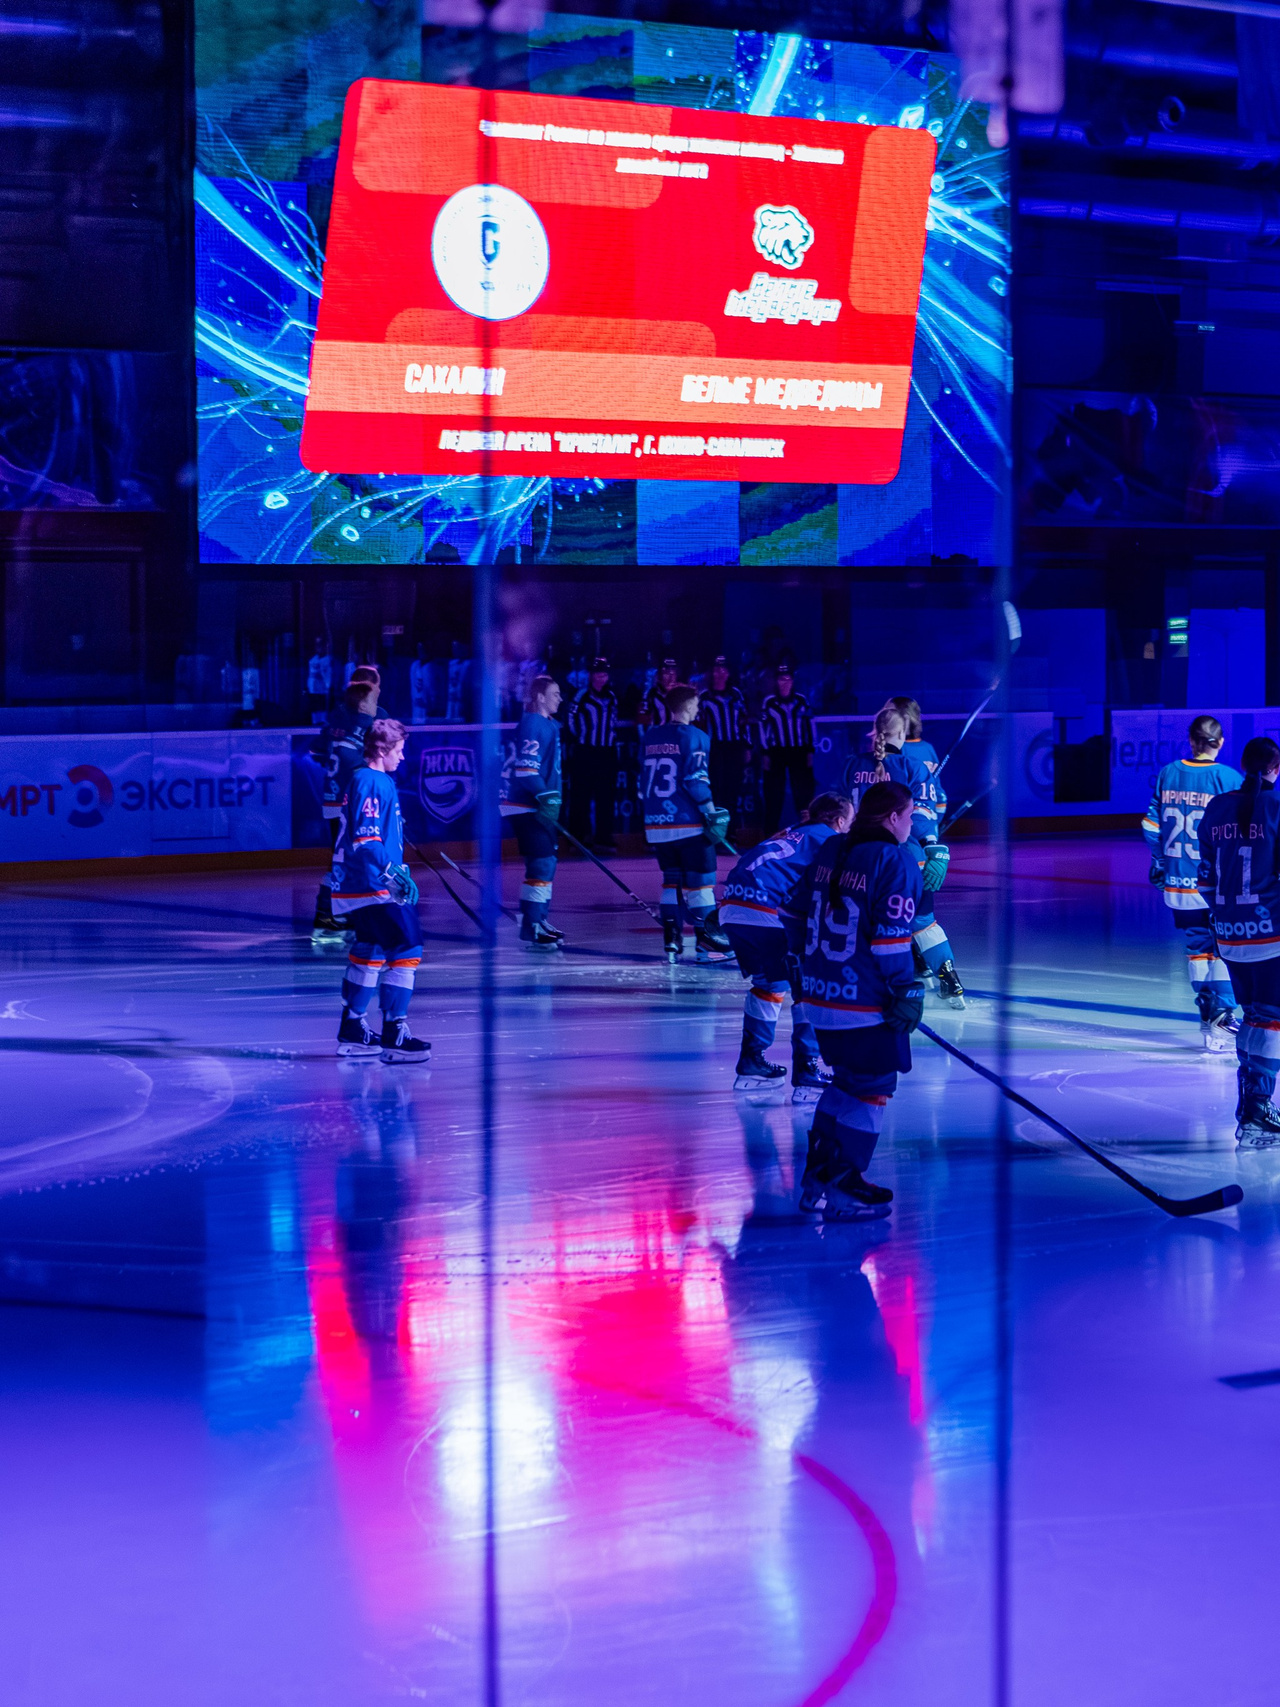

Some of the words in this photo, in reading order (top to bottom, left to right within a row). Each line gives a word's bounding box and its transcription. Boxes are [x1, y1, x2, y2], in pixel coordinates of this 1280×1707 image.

[521, 739, 540, 756] 22
[424, 752, 472, 775] ЖХЛ
[643, 757, 678, 798] 73
[120, 775, 276, 812] ЭКСПЕРТ
[919, 782, 938, 803] 18
[1215, 846, 1260, 905] 11
[886, 894, 916, 923] 99
